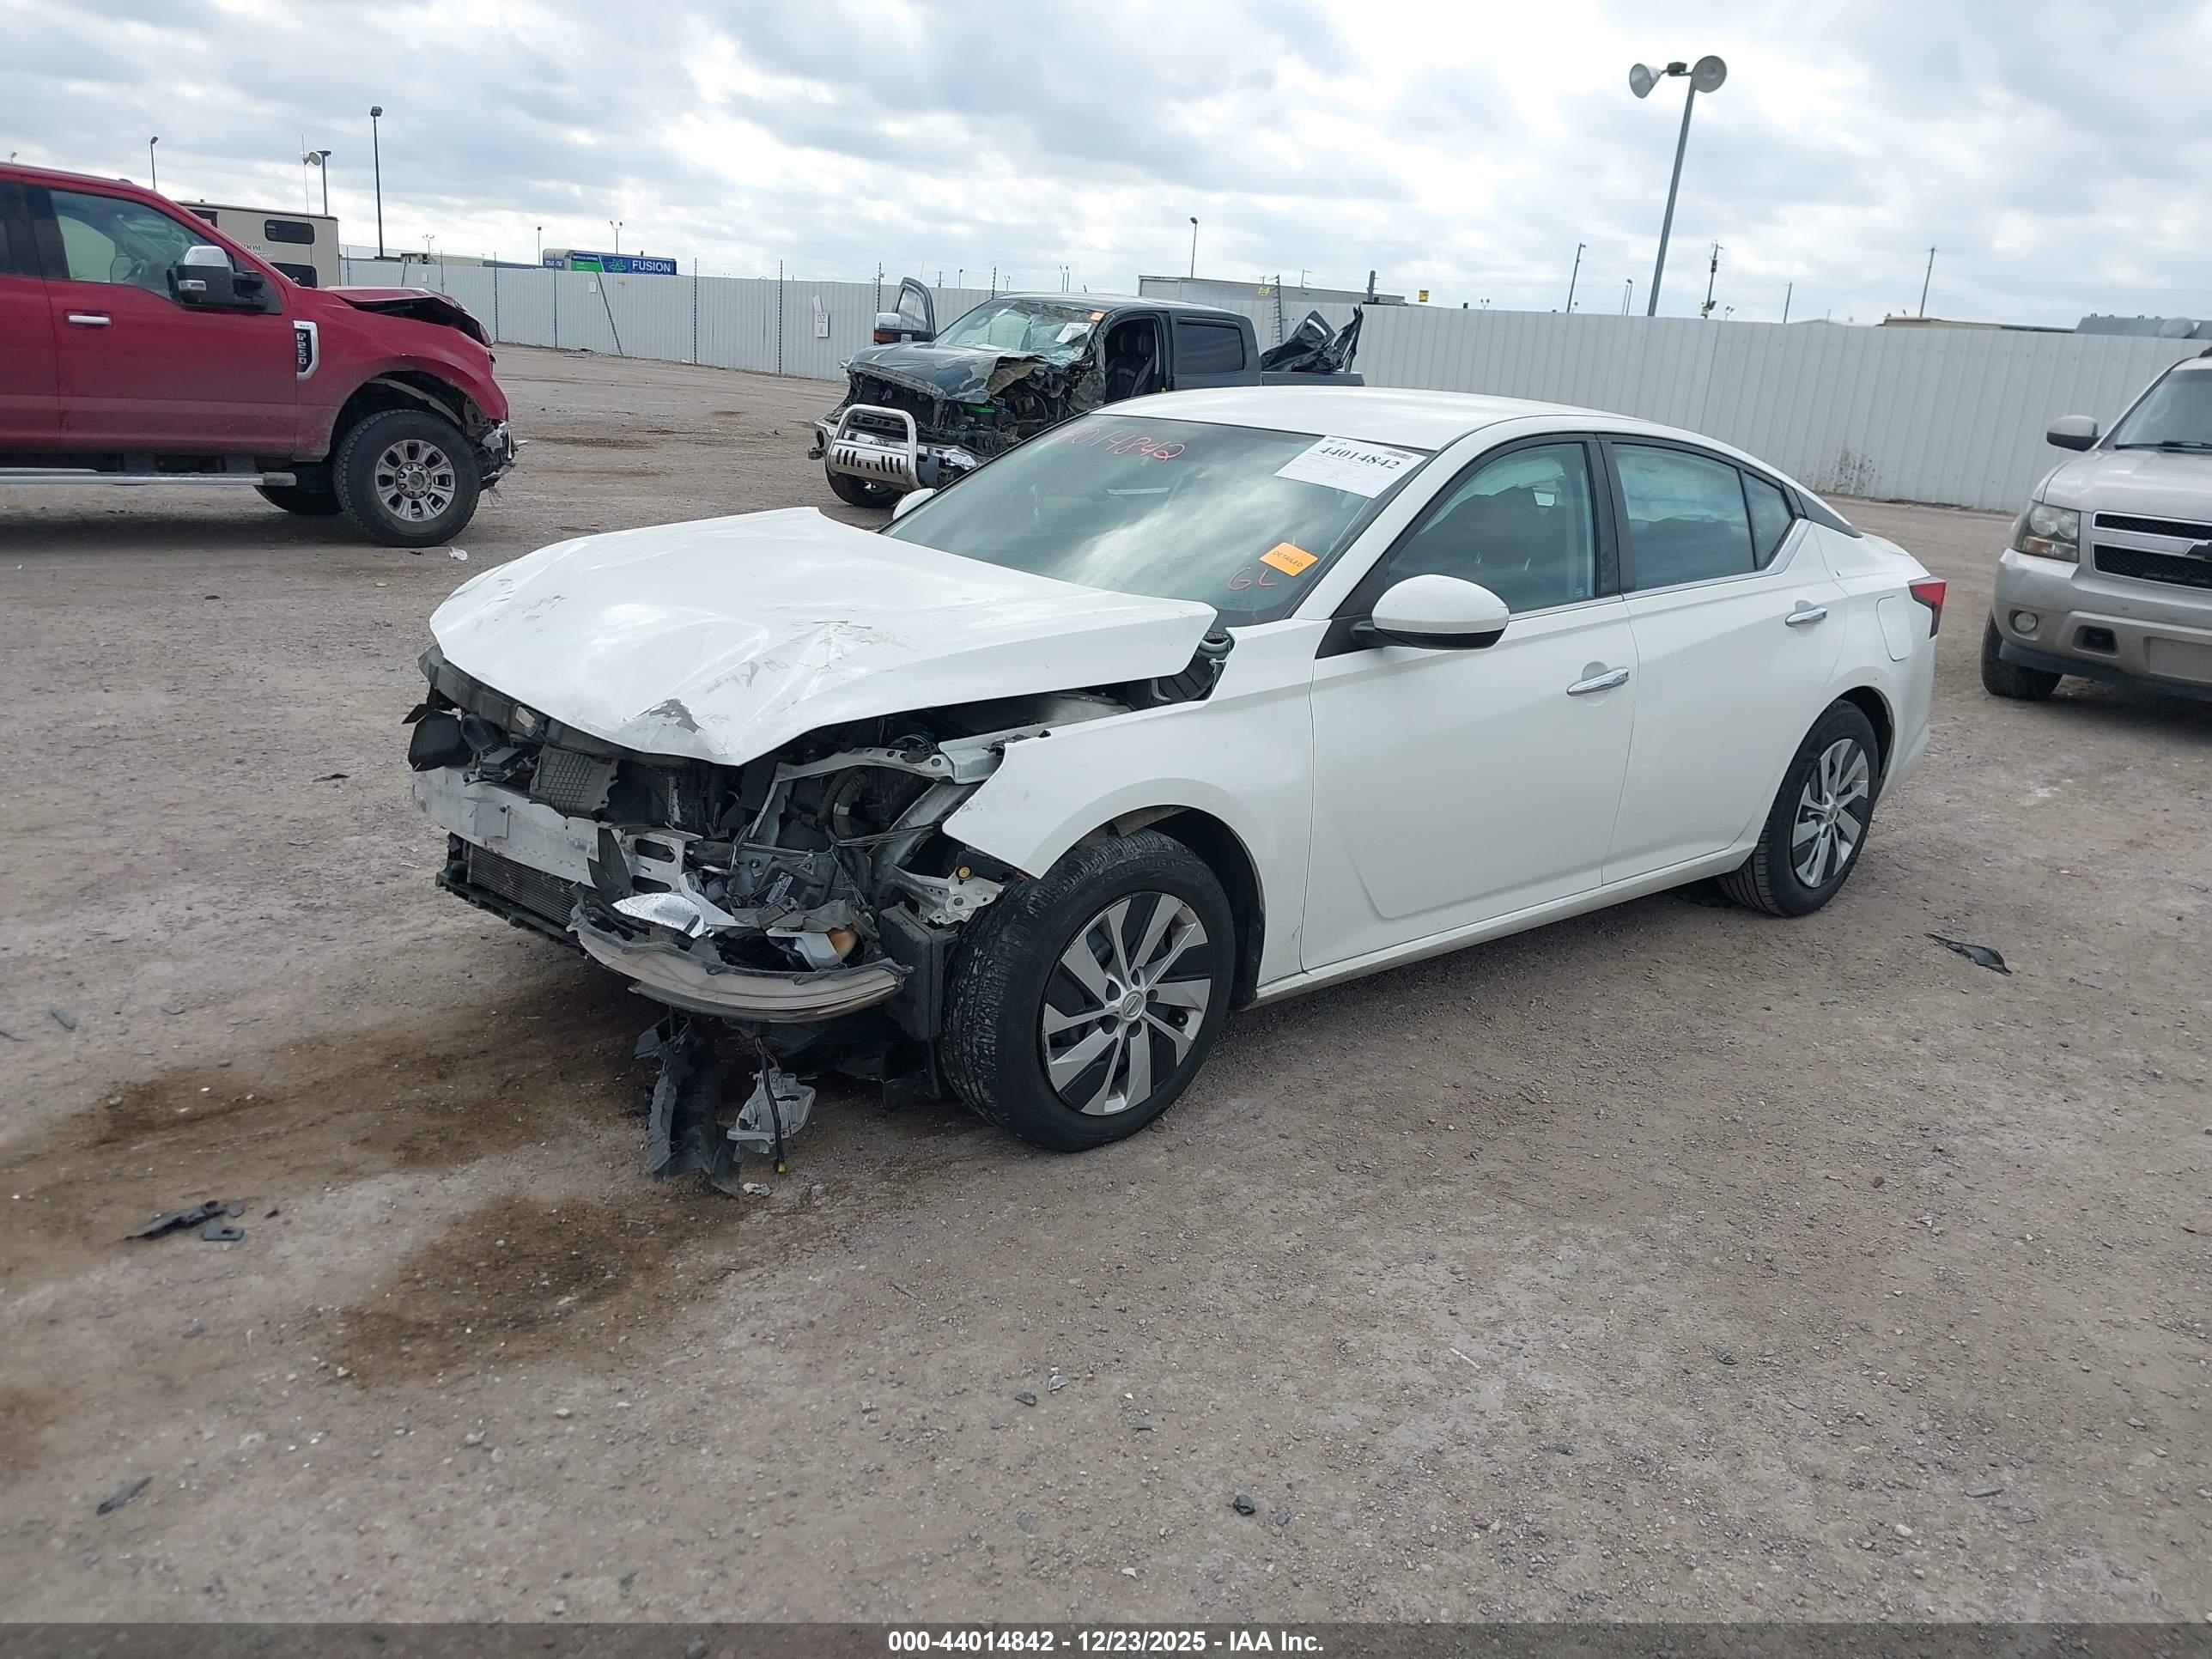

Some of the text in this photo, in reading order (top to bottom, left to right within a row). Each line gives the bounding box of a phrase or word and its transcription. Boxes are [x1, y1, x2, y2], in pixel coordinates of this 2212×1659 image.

[632, 260, 671, 272] FUSION
[296, 332, 307, 364] F250
[1319, 447, 1401, 470] 44014842
[1273, 550, 1304, 568] DETAILED
